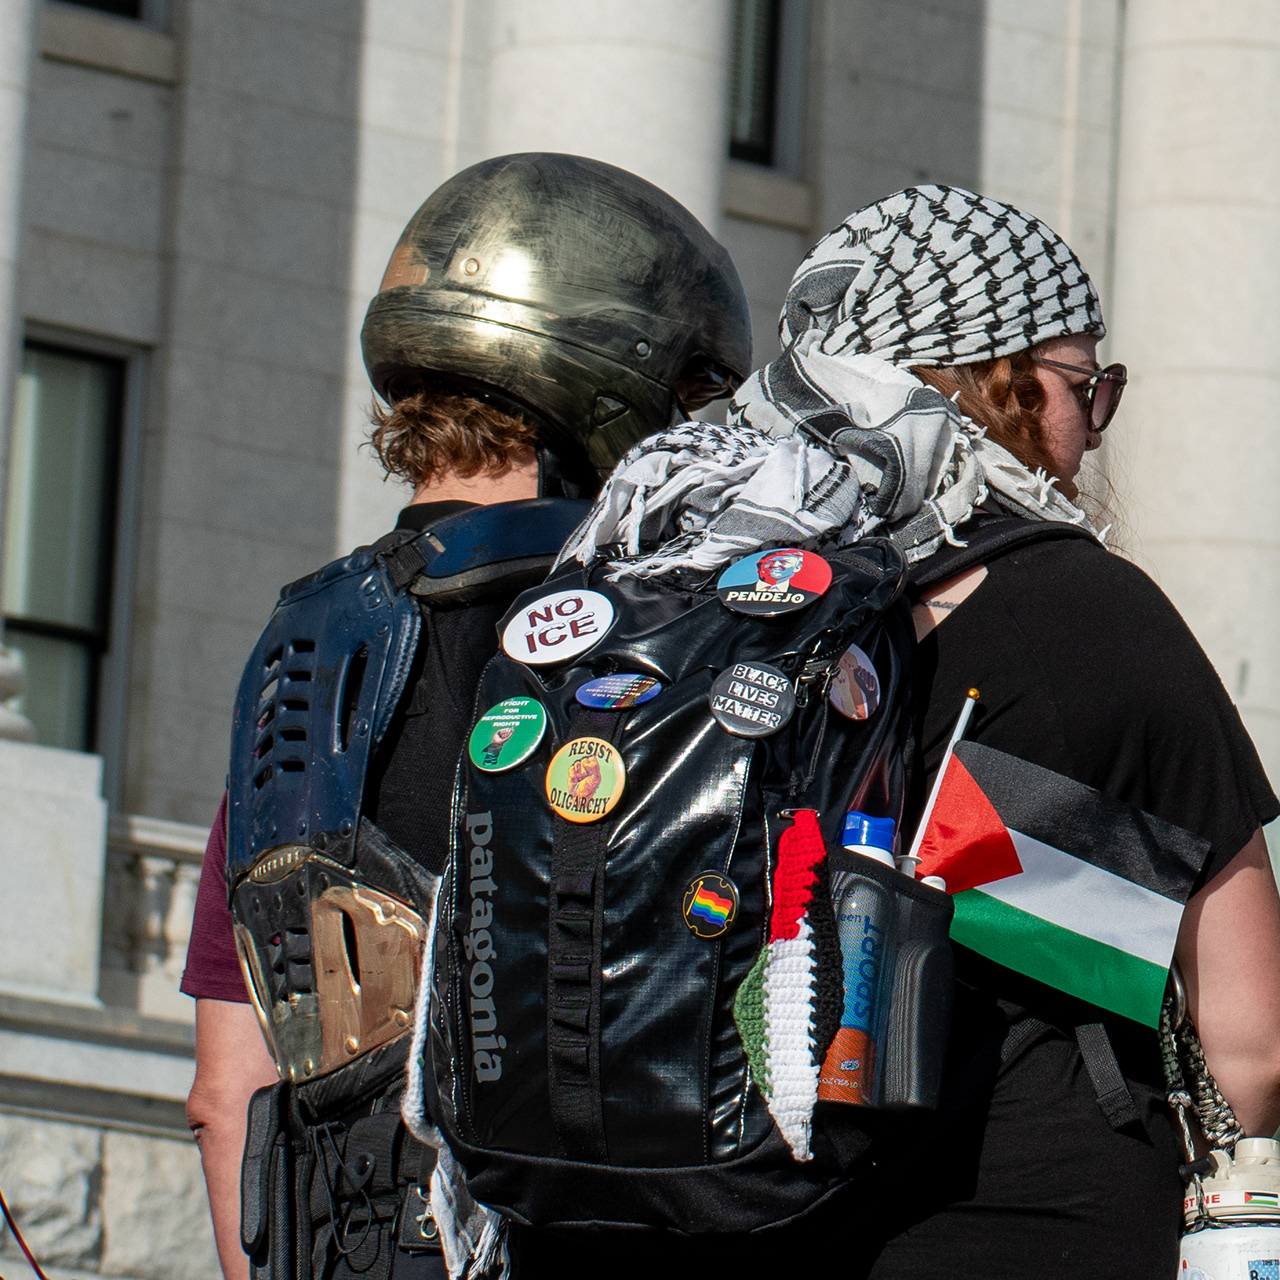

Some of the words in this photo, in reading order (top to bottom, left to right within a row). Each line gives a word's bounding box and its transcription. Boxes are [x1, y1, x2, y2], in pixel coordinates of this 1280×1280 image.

[527, 596, 584, 628] NO
[726, 591, 805, 604] PENDEJO
[524, 612, 599, 653] ICE
[732, 664, 789, 693] BLACK
[728, 681, 780, 709] LIVES
[712, 695, 782, 729] MATTER
[568, 740, 613, 764] RESIST
[550, 787, 611, 815] OLIGARCHY
[463, 810, 508, 1084] patagonia
[853, 915, 880, 1019] SPORT
